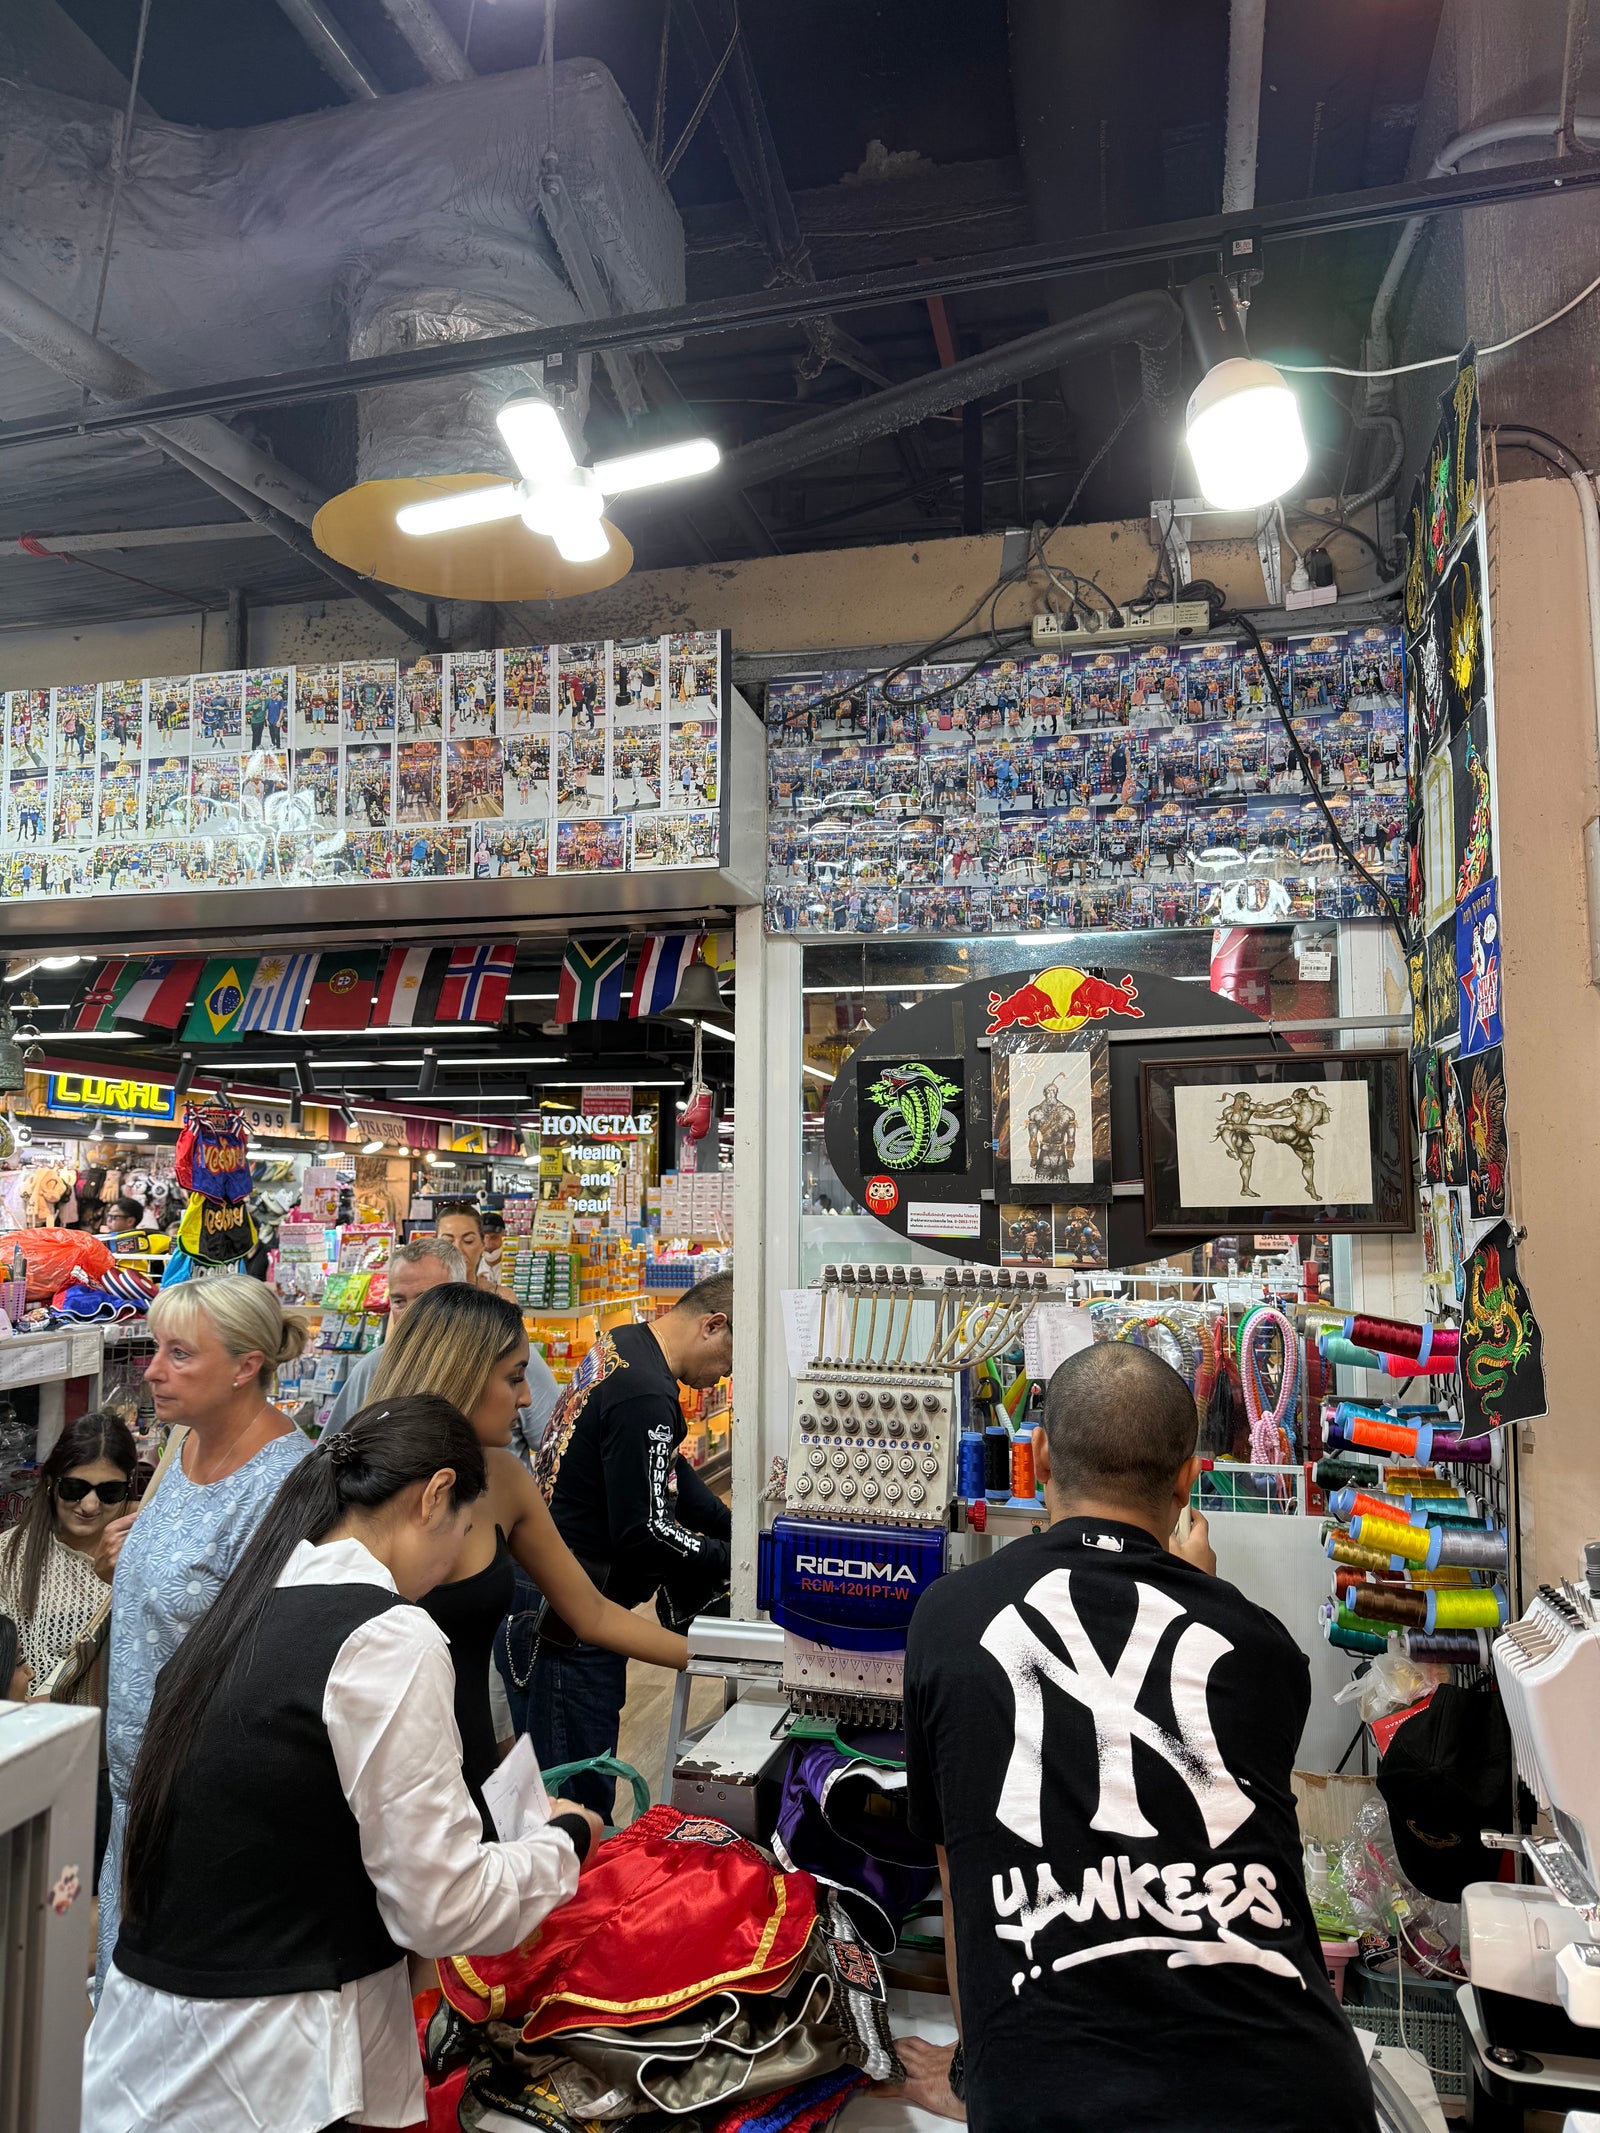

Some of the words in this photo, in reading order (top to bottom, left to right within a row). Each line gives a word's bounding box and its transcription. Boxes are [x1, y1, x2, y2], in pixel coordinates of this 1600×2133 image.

[359, 1119, 382, 1137] VISA
[382, 1122, 404, 1139] SHOP
[541, 1114, 654, 1135] HONGTAE
[570, 1145, 621, 1160] Health
[580, 1171, 611, 1187] and
[801, 1577, 909, 1600] RCM-1201PT-W
[980, 1568, 1256, 1849] NY
[1239, 1778, 1251, 1786] TM
[992, 1855, 1284, 1960] YANKEES
